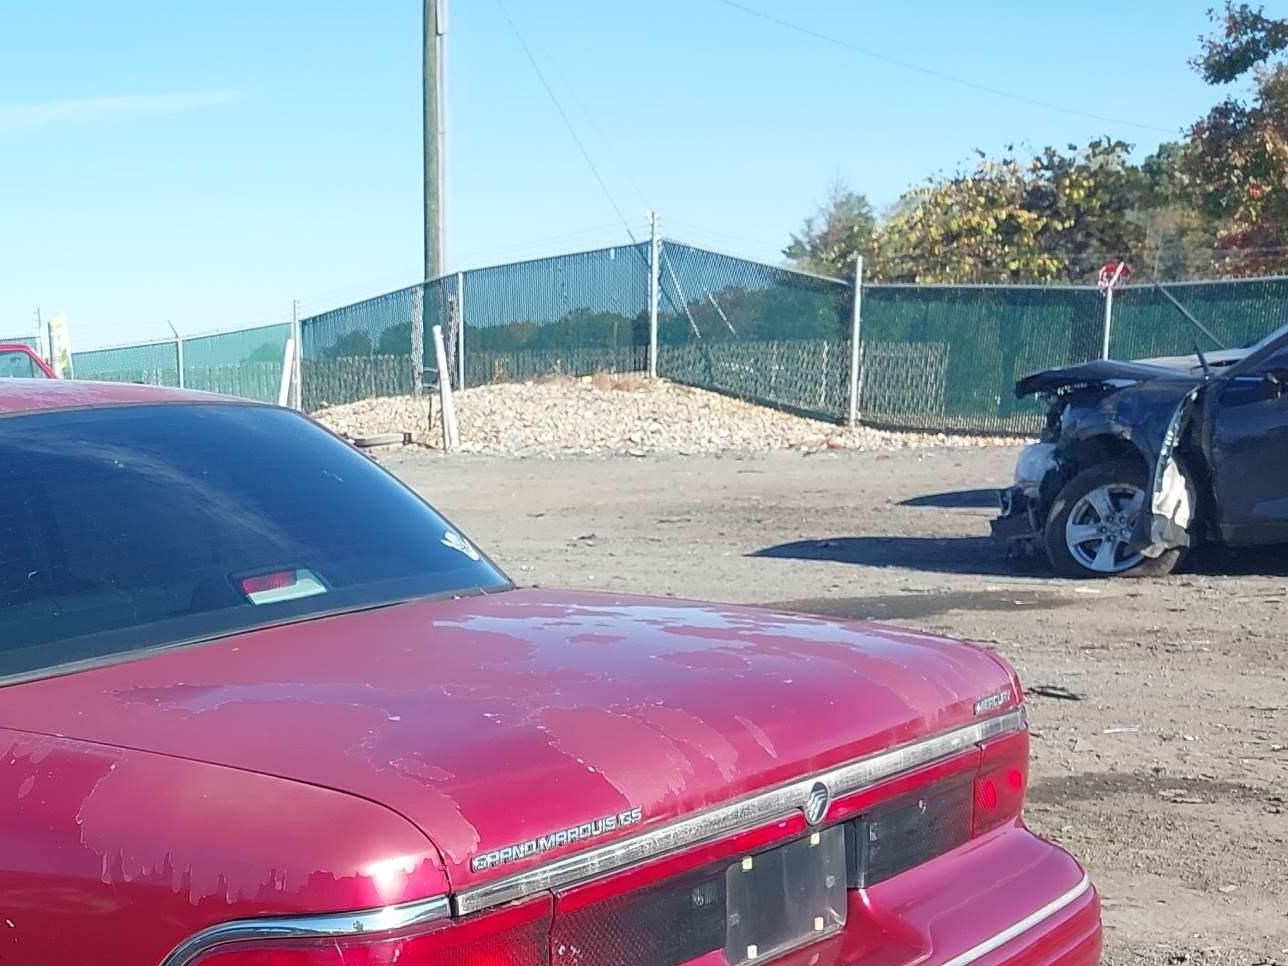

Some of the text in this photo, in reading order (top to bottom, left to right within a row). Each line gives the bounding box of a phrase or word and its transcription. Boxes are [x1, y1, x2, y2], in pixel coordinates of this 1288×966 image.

[472, 806, 643, 873] GRAND MARQUIS GS
